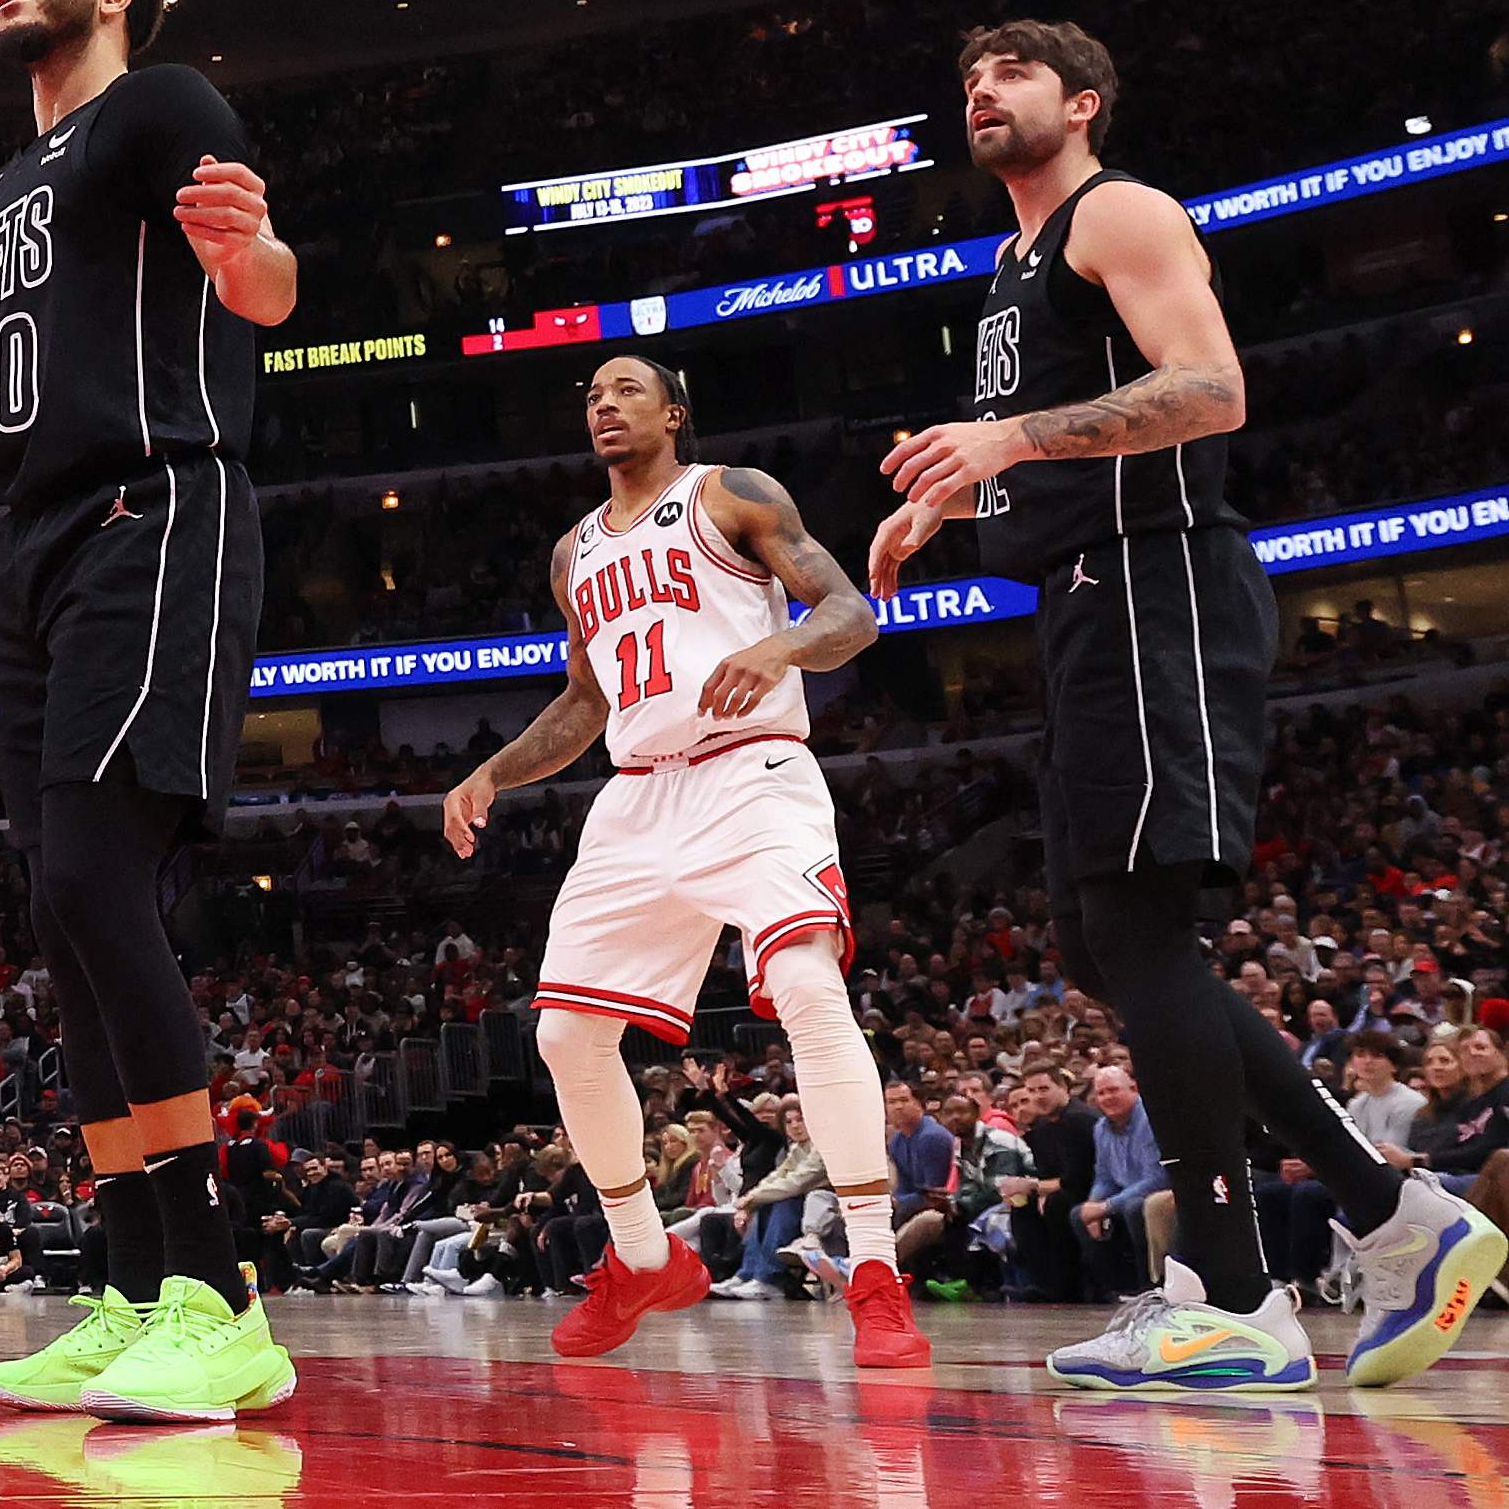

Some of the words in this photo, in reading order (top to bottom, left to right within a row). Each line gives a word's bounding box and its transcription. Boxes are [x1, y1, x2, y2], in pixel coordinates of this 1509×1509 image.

[731, 141, 914, 193] SMOKEOUT
[744, 140, 828, 171] WINDY
[831, 124, 893, 156] CITY
[537, 183, 579, 205] WINDY
[578, 177, 611, 202] CITY
[612, 169, 683, 194] SMOKEOUT
[1213, 181, 1299, 220] WORTH
[1300, 175, 1323, 199] IT
[1324, 168, 1349, 193] IF
[1351, 155, 1404, 185] YOU
[1406, 133, 1488, 172] ENJOY
[716, 274, 824, 317] Michelob
[848, 241, 968, 291] ULTRA
[488, 317, 505, 334] 14
[492, 334, 504, 351] 2
[263, 348, 305, 374] FAST
[306, 341, 363, 369] BREAK
[363, 333, 426, 362] POINTS
[974, 305, 1021, 405] ETS
[1251, 527, 1346, 563] WORTH
[1349, 522, 1375, 548] IT
[1377, 517, 1405, 543] IF
[1407, 505, 1470, 537] YOU
[576, 548, 701, 641] BULLS
[280, 658, 366, 685] WORTH
[370, 656, 392, 678] IT
[395, 654, 417, 676] IF
[421, 650, 472, 673] YOU
[476, 642, 555, 669] ENJOY
[615, 619, 673, 712] 11
